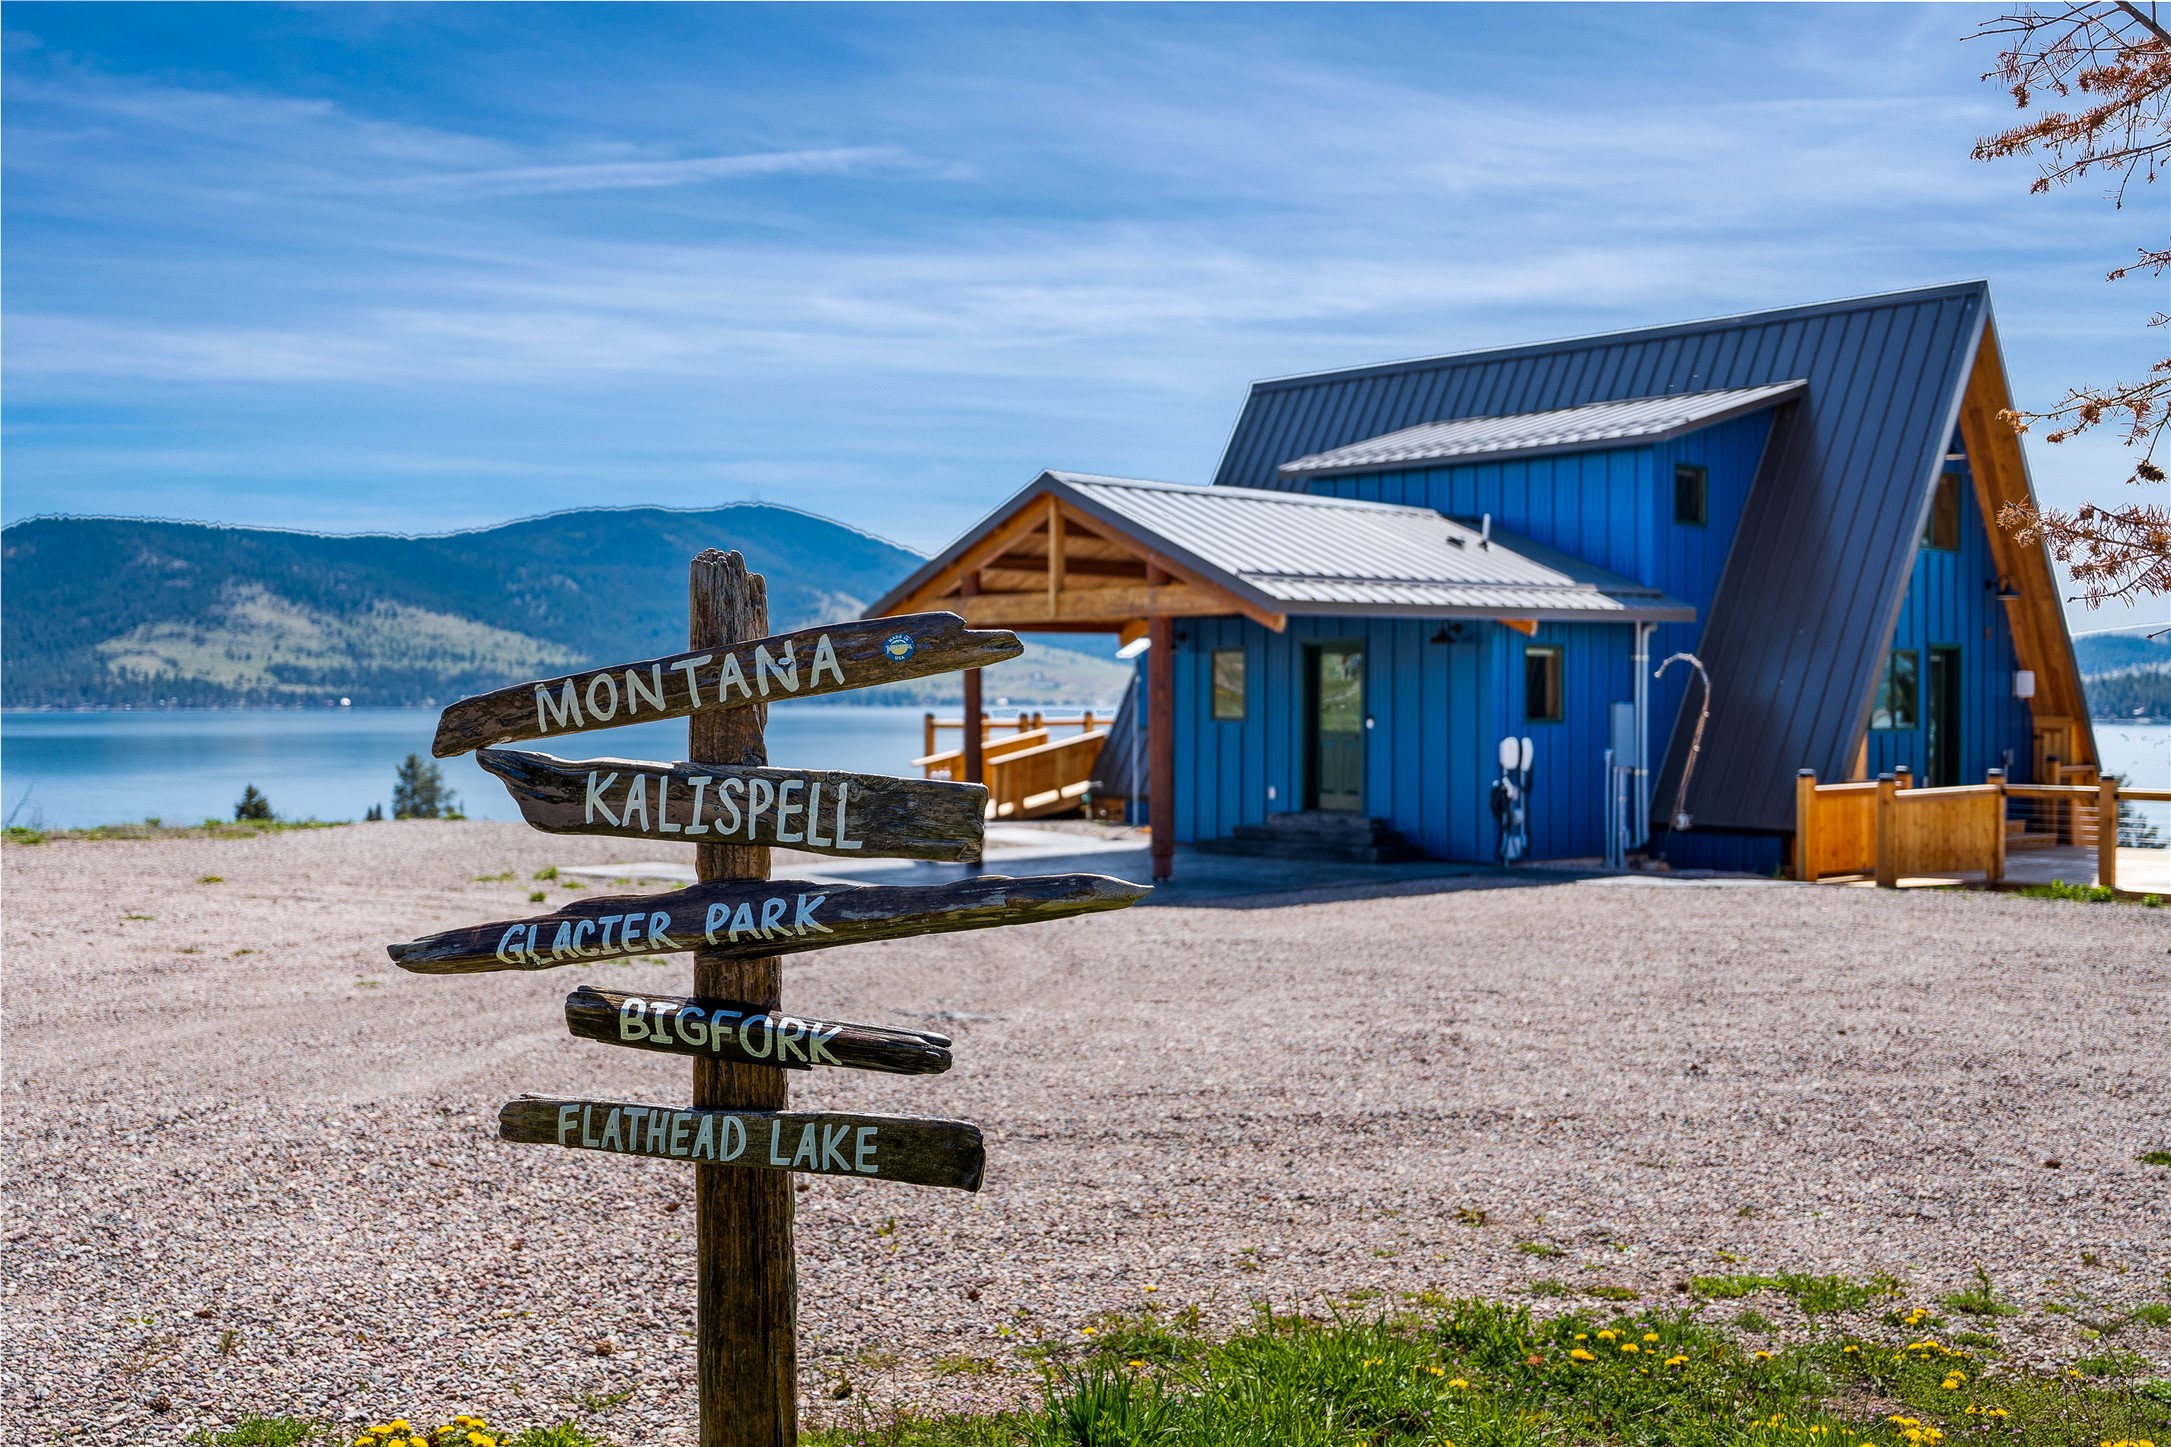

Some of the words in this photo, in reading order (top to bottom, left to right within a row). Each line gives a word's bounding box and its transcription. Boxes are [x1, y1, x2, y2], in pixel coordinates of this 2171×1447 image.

[534, 634, 845, 732] MONTANA
[585, 771, 863, 850] KALISPELL
[496, 910, 679, 967] GLACIER
[704, 893, 833, 945] PARK
[620, 998, 843, 1066] BIGFORK
[557, 1104, 747, 1162] FLATHEAD
[769, 1111, 879, 1173] LAKE
